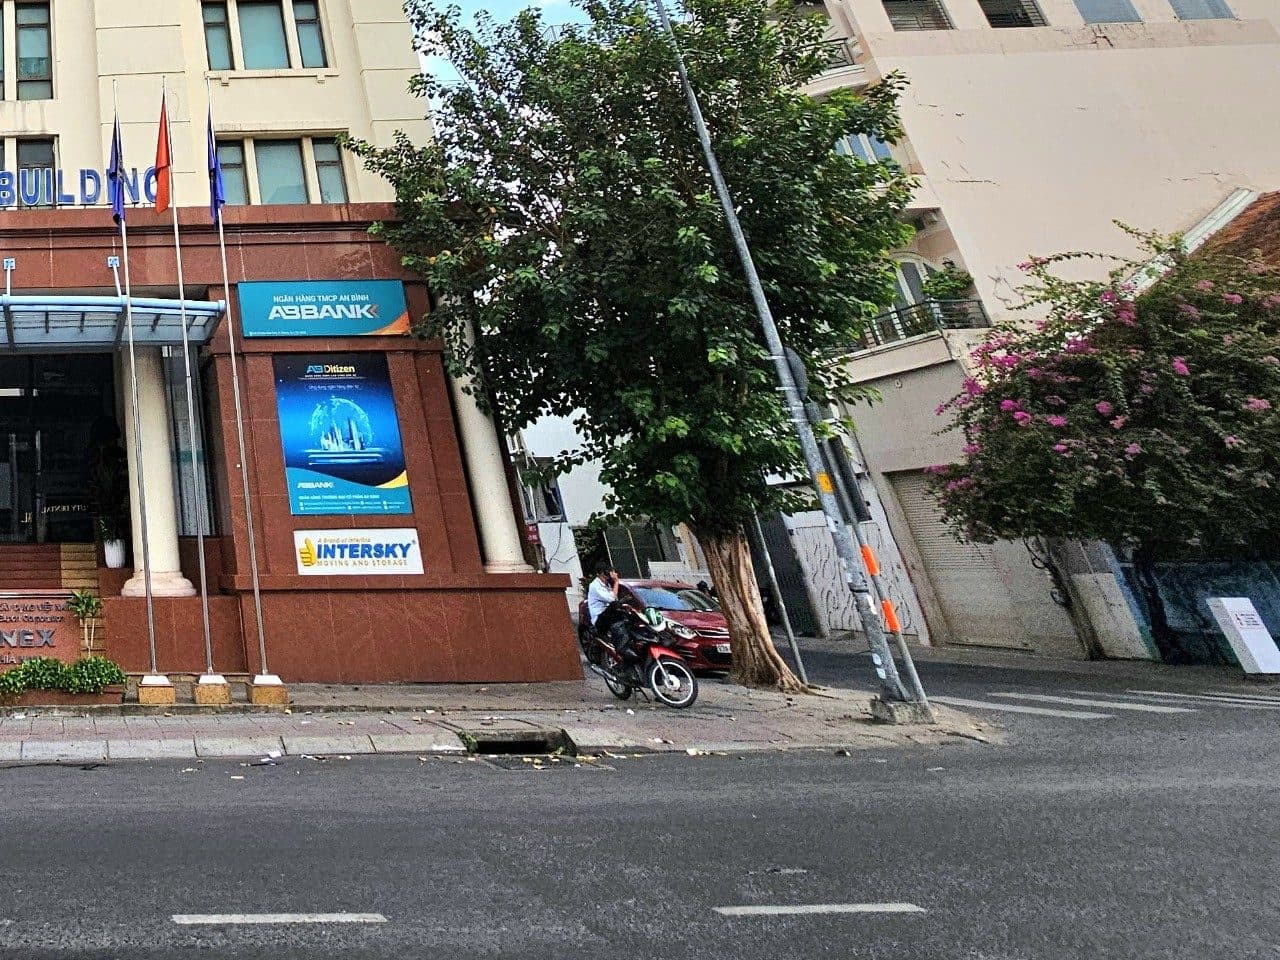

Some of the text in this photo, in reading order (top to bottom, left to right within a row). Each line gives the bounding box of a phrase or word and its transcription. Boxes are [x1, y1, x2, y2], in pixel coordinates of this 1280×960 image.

[273, 293, 369, 303] NGÂN HÀNG TMCP AN BÌNH
[268, 304, 374, 320] ABBANK
[317, 543, 411, 559] INTERSKY
[317, 559, 349, 567] MOVING
